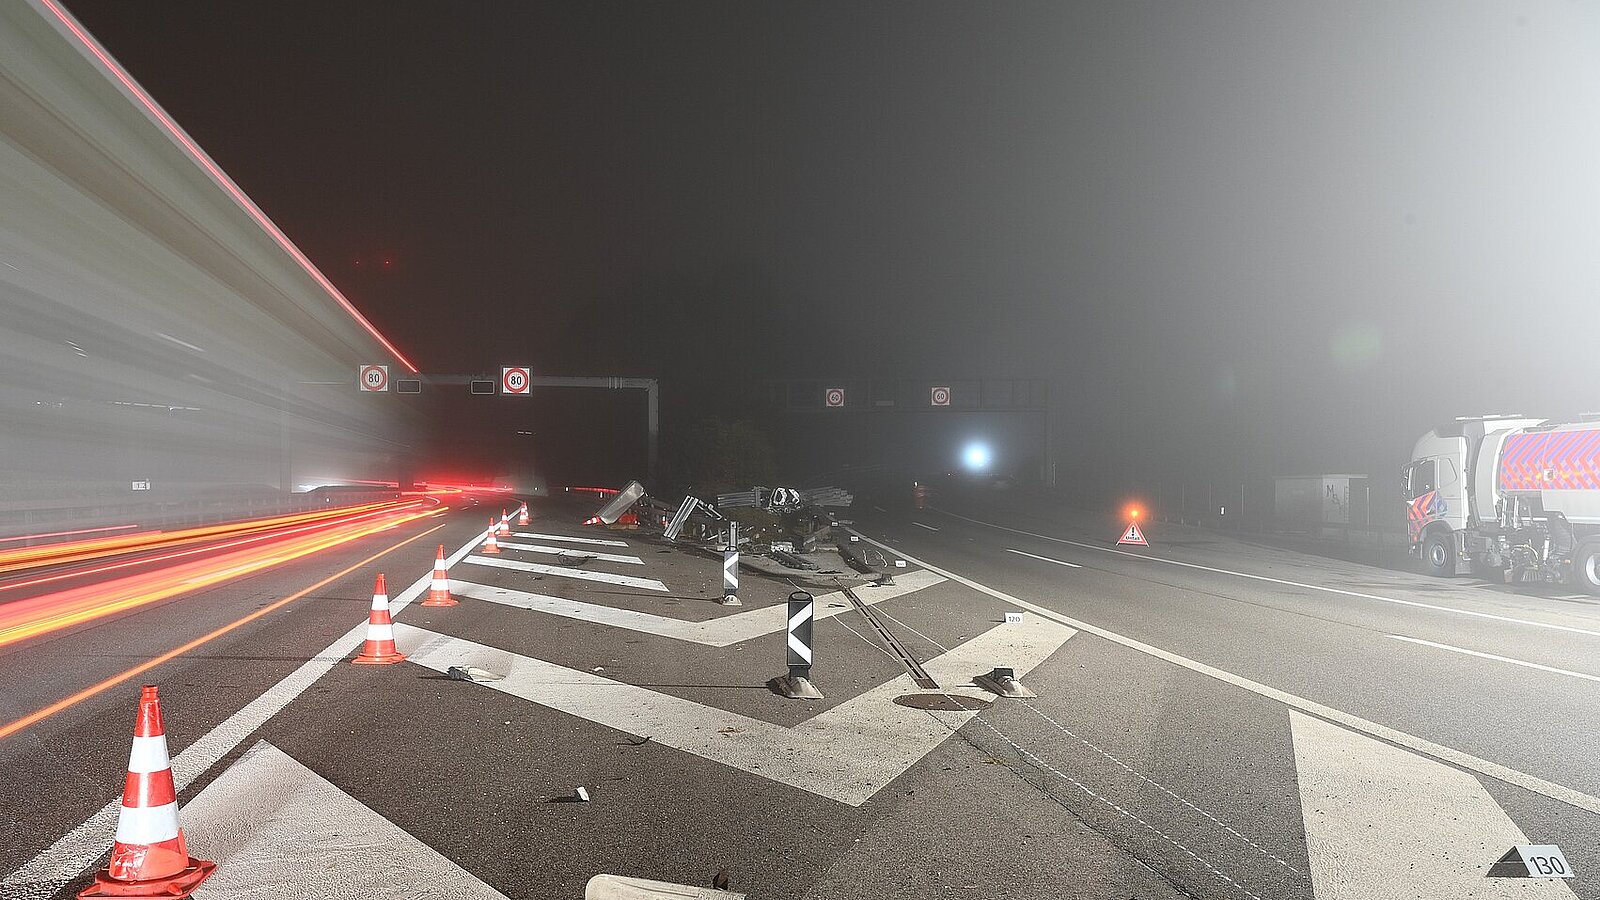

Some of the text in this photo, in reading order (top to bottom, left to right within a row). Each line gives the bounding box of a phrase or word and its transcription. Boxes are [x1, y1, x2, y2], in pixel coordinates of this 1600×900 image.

[368, 373, 380, 383] 80
[510, 375, 522, 386] 80
[936, 392, 945, 400] 60
[1529, 856, 1565, 875] 130
